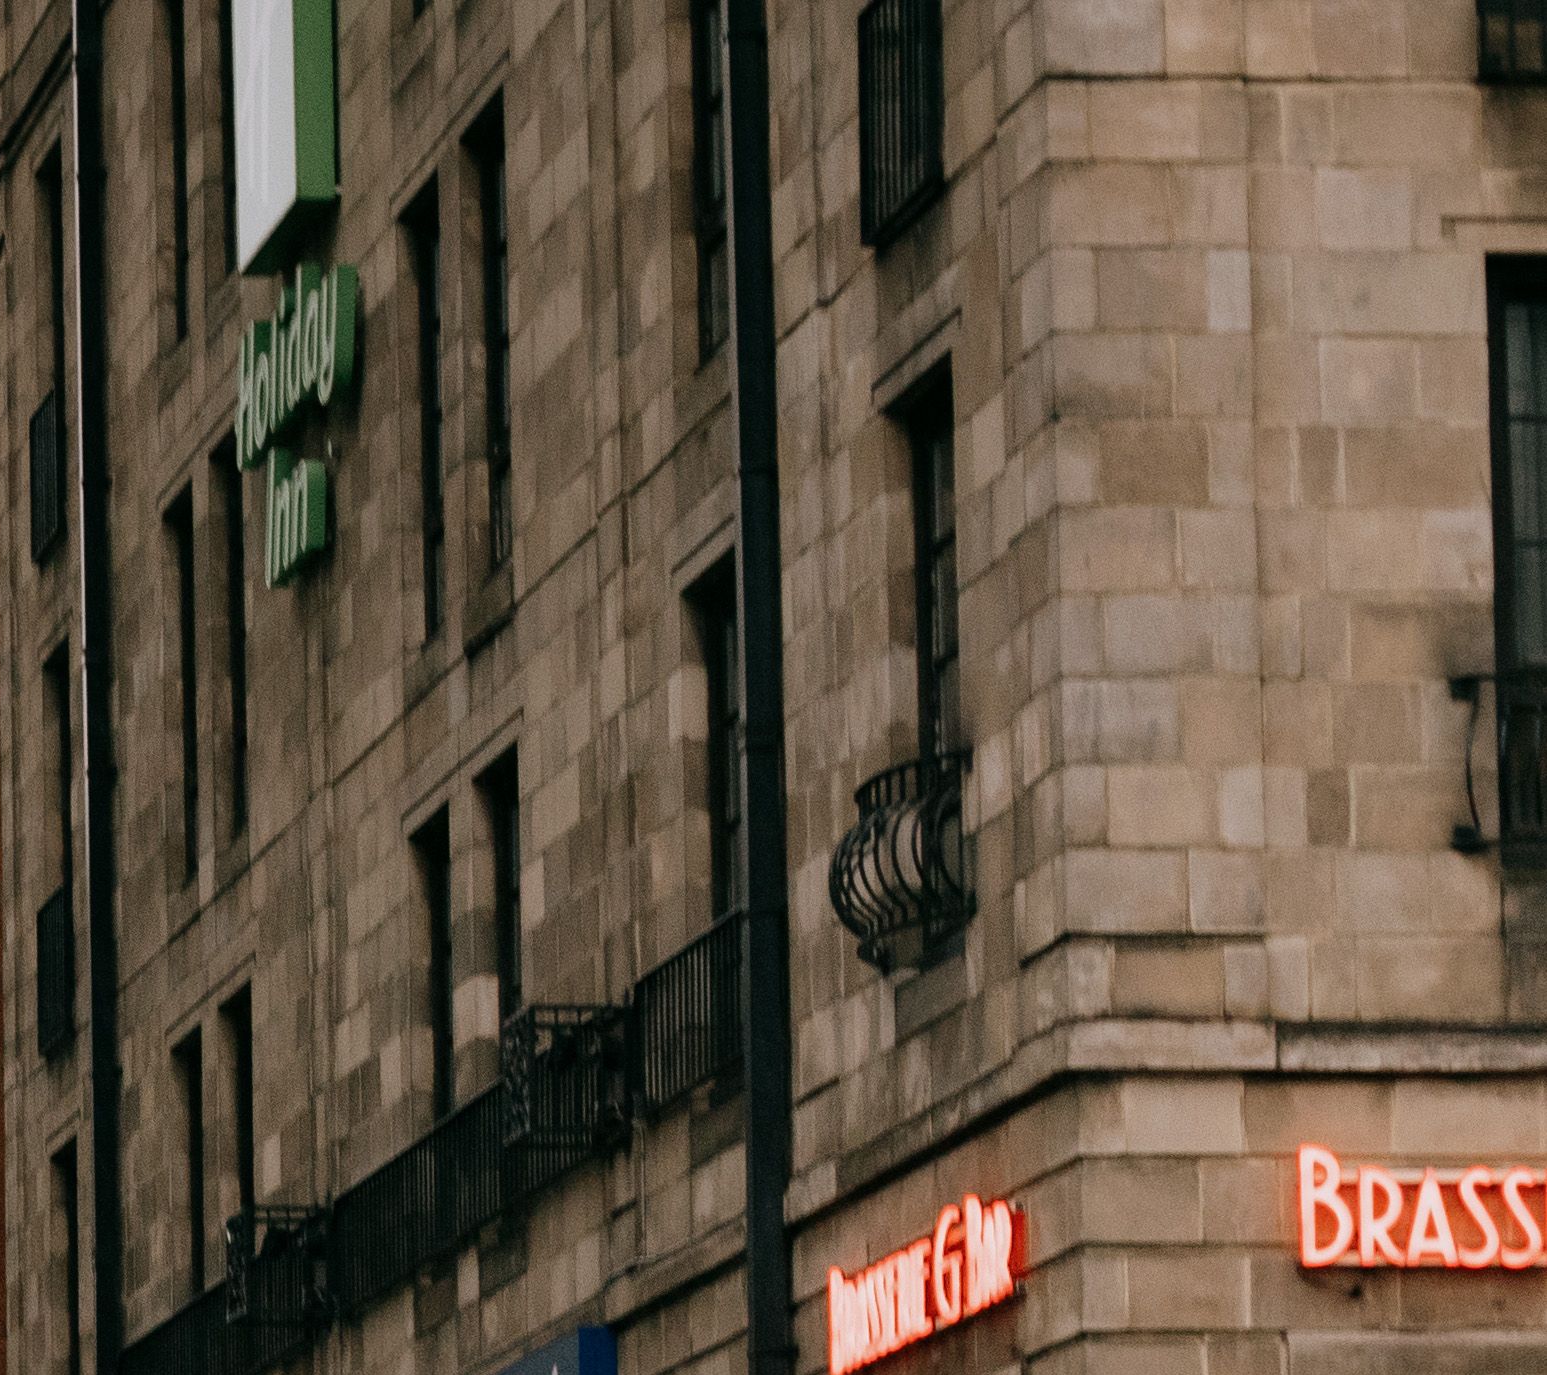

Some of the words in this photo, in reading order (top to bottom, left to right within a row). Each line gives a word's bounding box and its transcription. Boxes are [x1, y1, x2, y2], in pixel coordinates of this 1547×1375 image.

[235, 262, 340, 472] Holiday
[263, 446, 310, 590] Inn
[1296, 1141, 1547, 1270] BRASS
